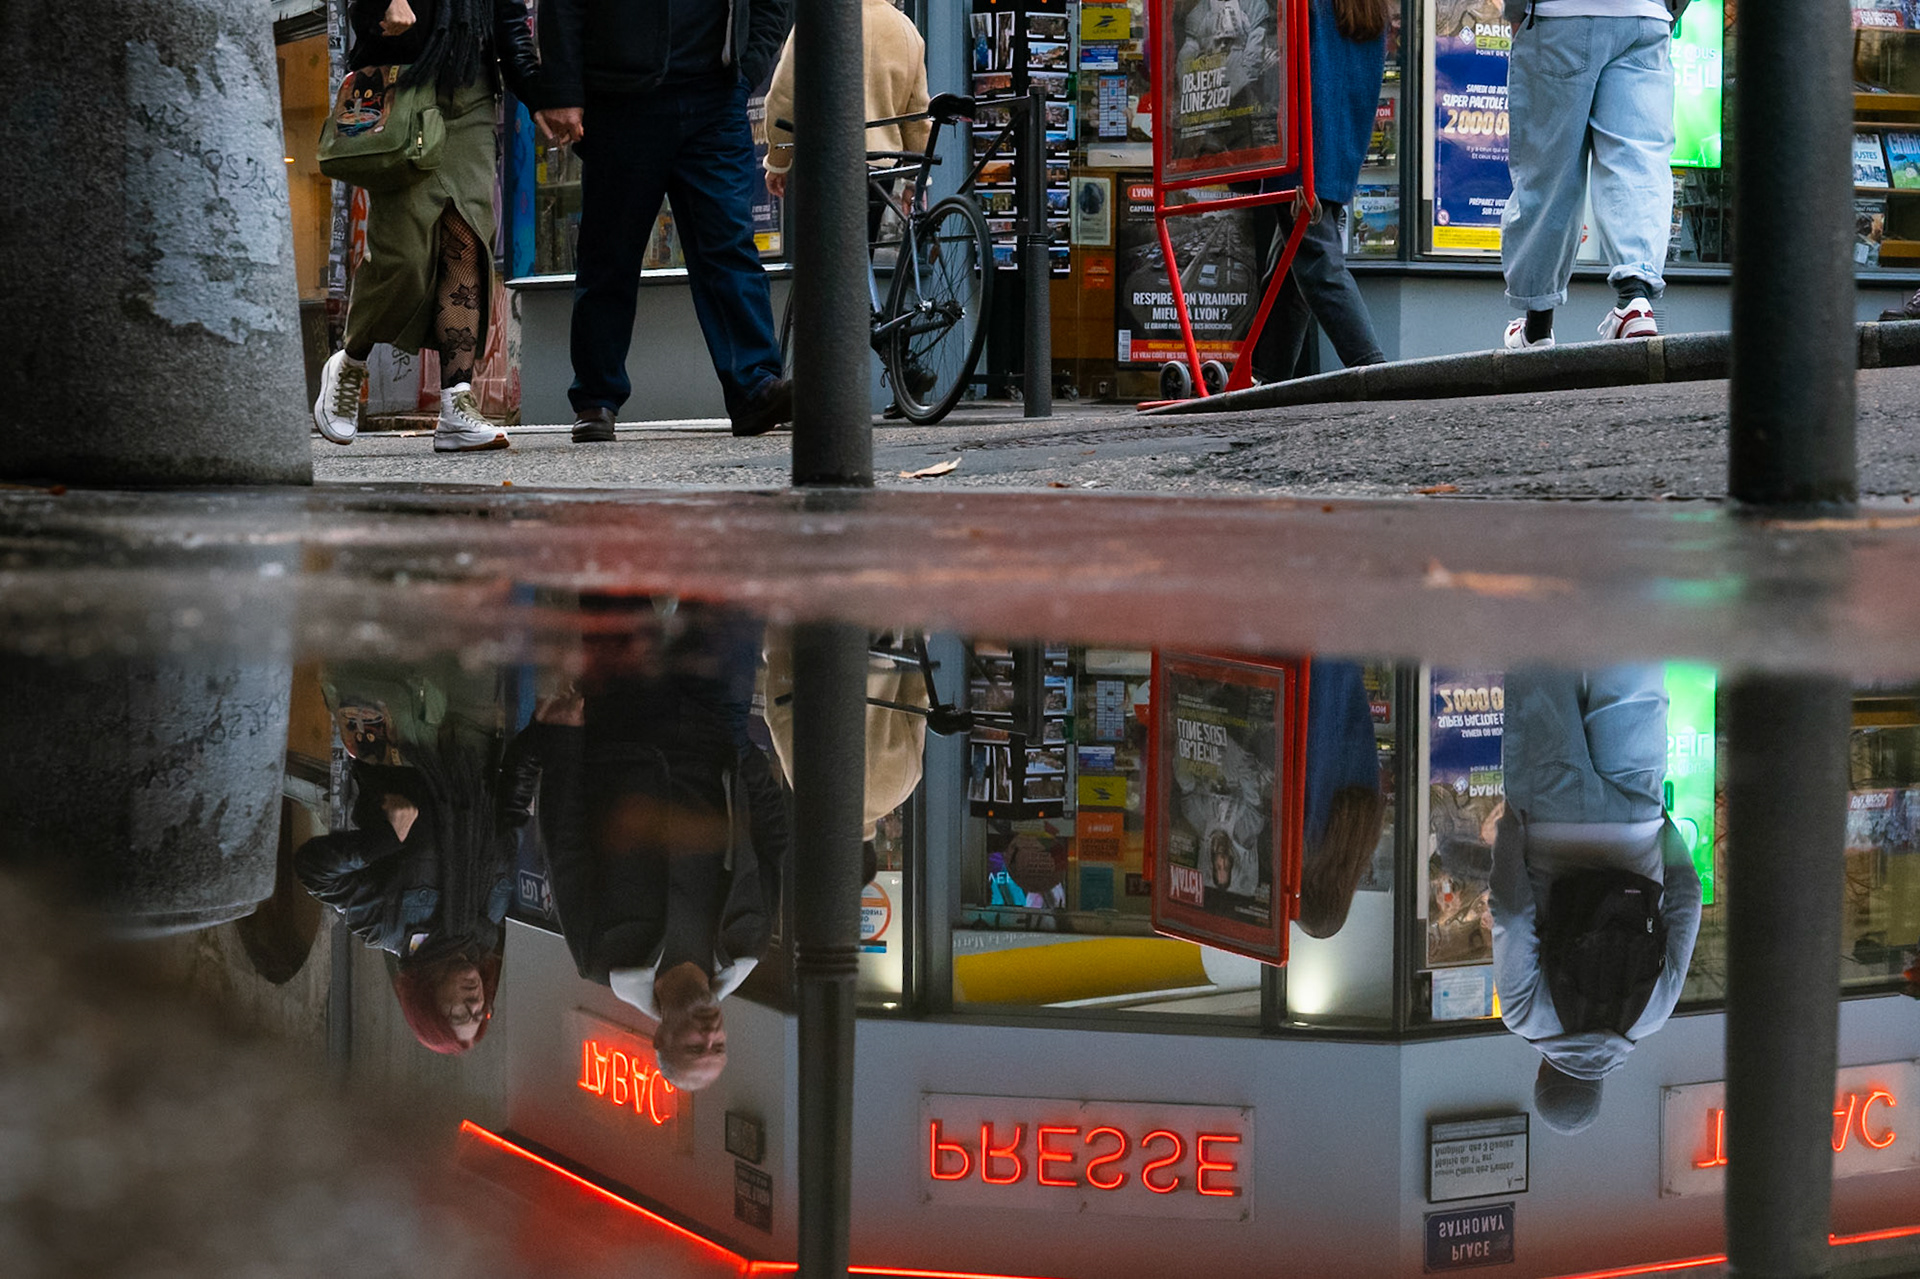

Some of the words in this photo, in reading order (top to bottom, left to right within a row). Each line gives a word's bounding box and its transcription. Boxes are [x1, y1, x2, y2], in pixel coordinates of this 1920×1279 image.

[1182, 67, 1227, 93] OBJECTIF
[1466, 84, 1488, 93] SAMEDI
[1180, 91, 1207, 114] LUNE
[1206, 86, 1231, 111] 2027
[1442, 94, 1469, 107] SUPER
[1469, 96, 1504, 110] PACTOLE
[1132, 188, 1153, 197] LYON
[1198, 293, 1247, 305] VRAIMENT
[1153, 307, 1178, 320] MIEU
[1195, 308, 1219, 320] LYON
